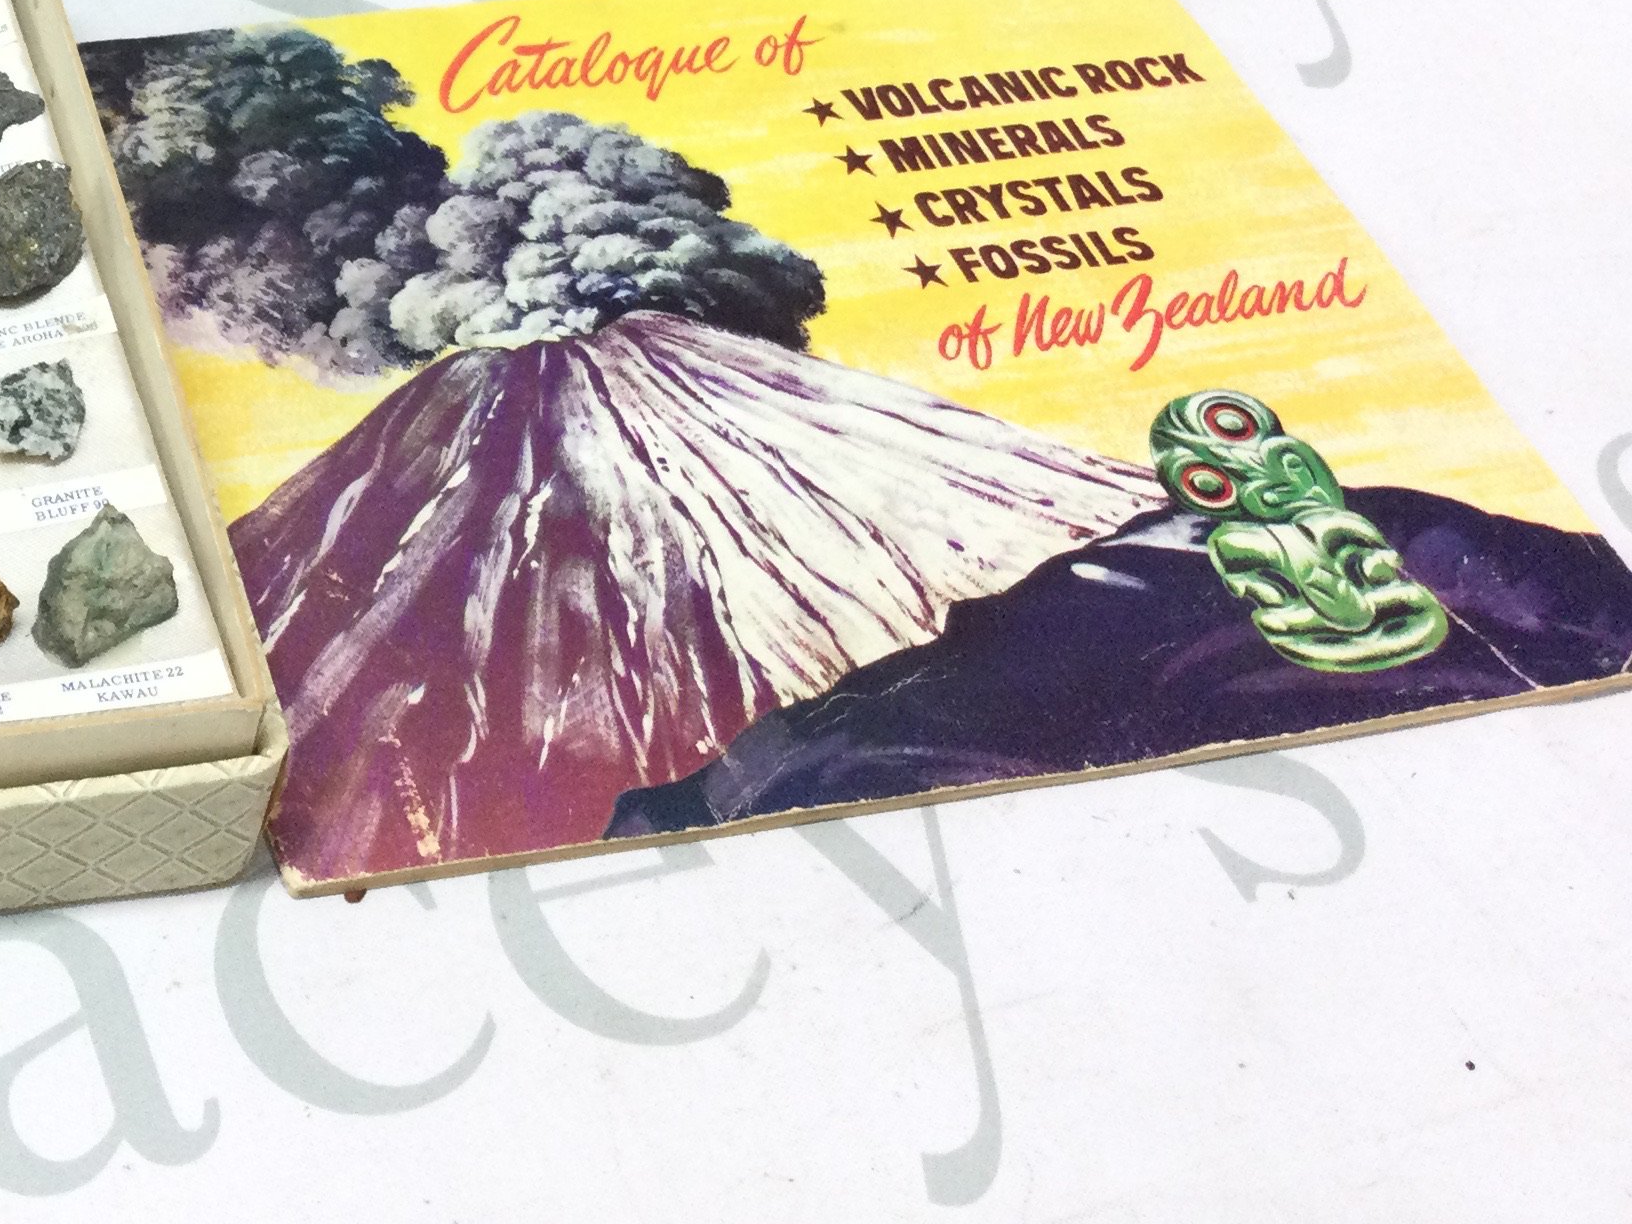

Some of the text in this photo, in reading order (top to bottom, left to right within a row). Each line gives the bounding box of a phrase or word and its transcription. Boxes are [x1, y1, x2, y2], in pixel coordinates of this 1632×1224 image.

[439, 14, 825, 113] Catalogue of
[841, 53, 1204, 125] VOLCANIC ROCK
[882, 115, 1126, 174] MINERALS
[922, 167, 1163, 228] CRYSTALS
[953, 226, 1155, 284] FOSSILS
[12, 329, 64, 347] AROHA
[937, 257, 1367, 373] of New Zealand
[31, 485, 104, 509] GRANITE
[35, 501, 90, 522] BLUFF
[61, 665, 185, 694] MALACHITE 22
[97, 685, 159, 704] KAWAU
